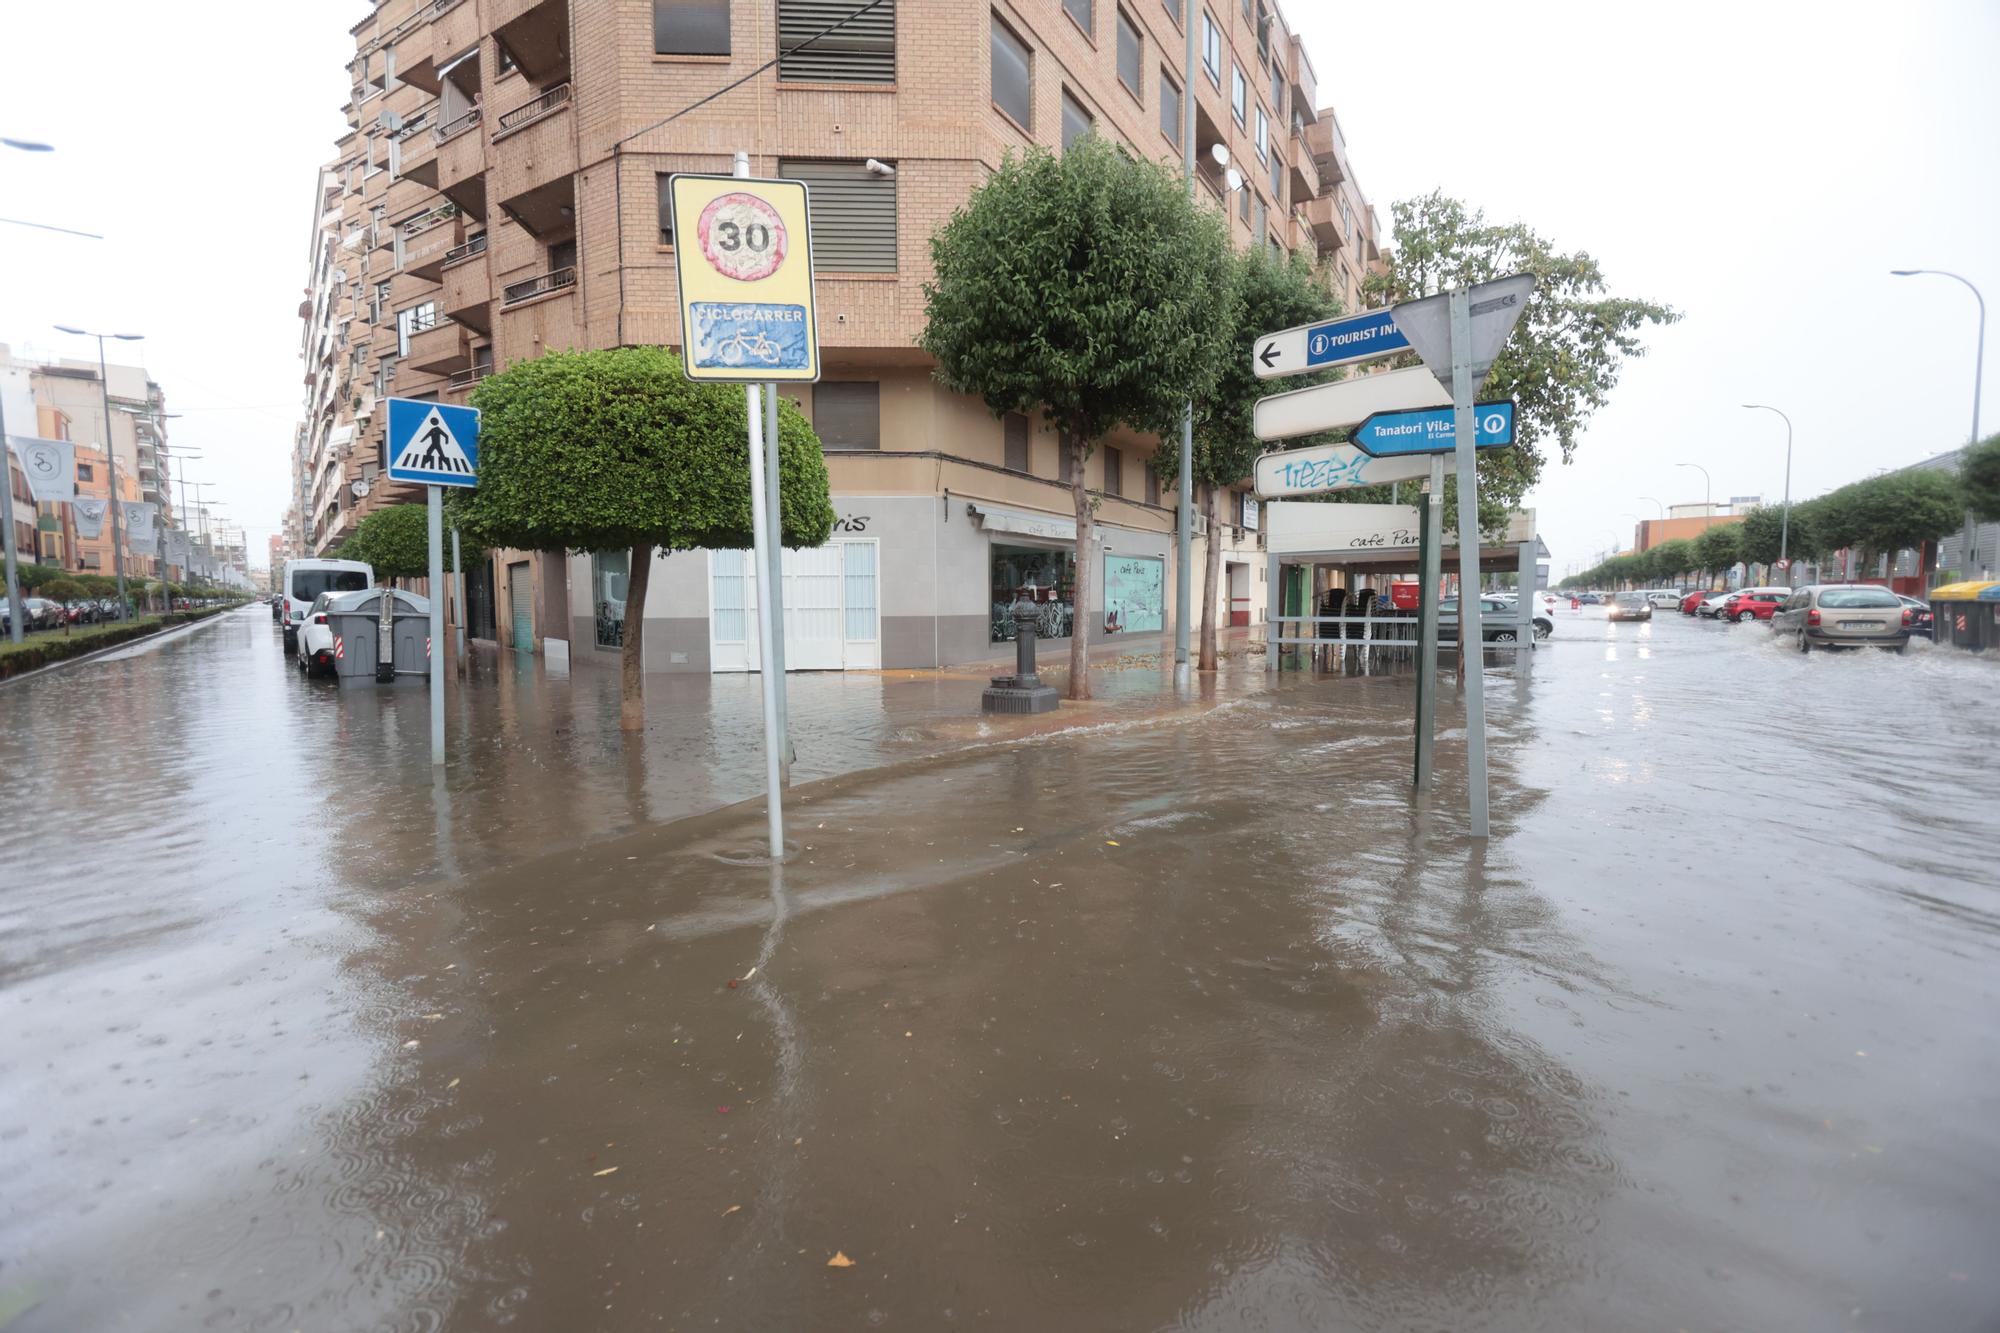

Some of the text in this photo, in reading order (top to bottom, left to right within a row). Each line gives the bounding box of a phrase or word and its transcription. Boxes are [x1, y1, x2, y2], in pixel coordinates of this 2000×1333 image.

[718, 222, 770, 252] 30
[696, 307, 803, 321] CICLOCARRER
[1331, 327, 1378, 347] TOURIST
[1374, 422, 1422, 437] Tanatori
[833, 513, 871, 532] ris
[1350, 529, 1420, 547] café Par
